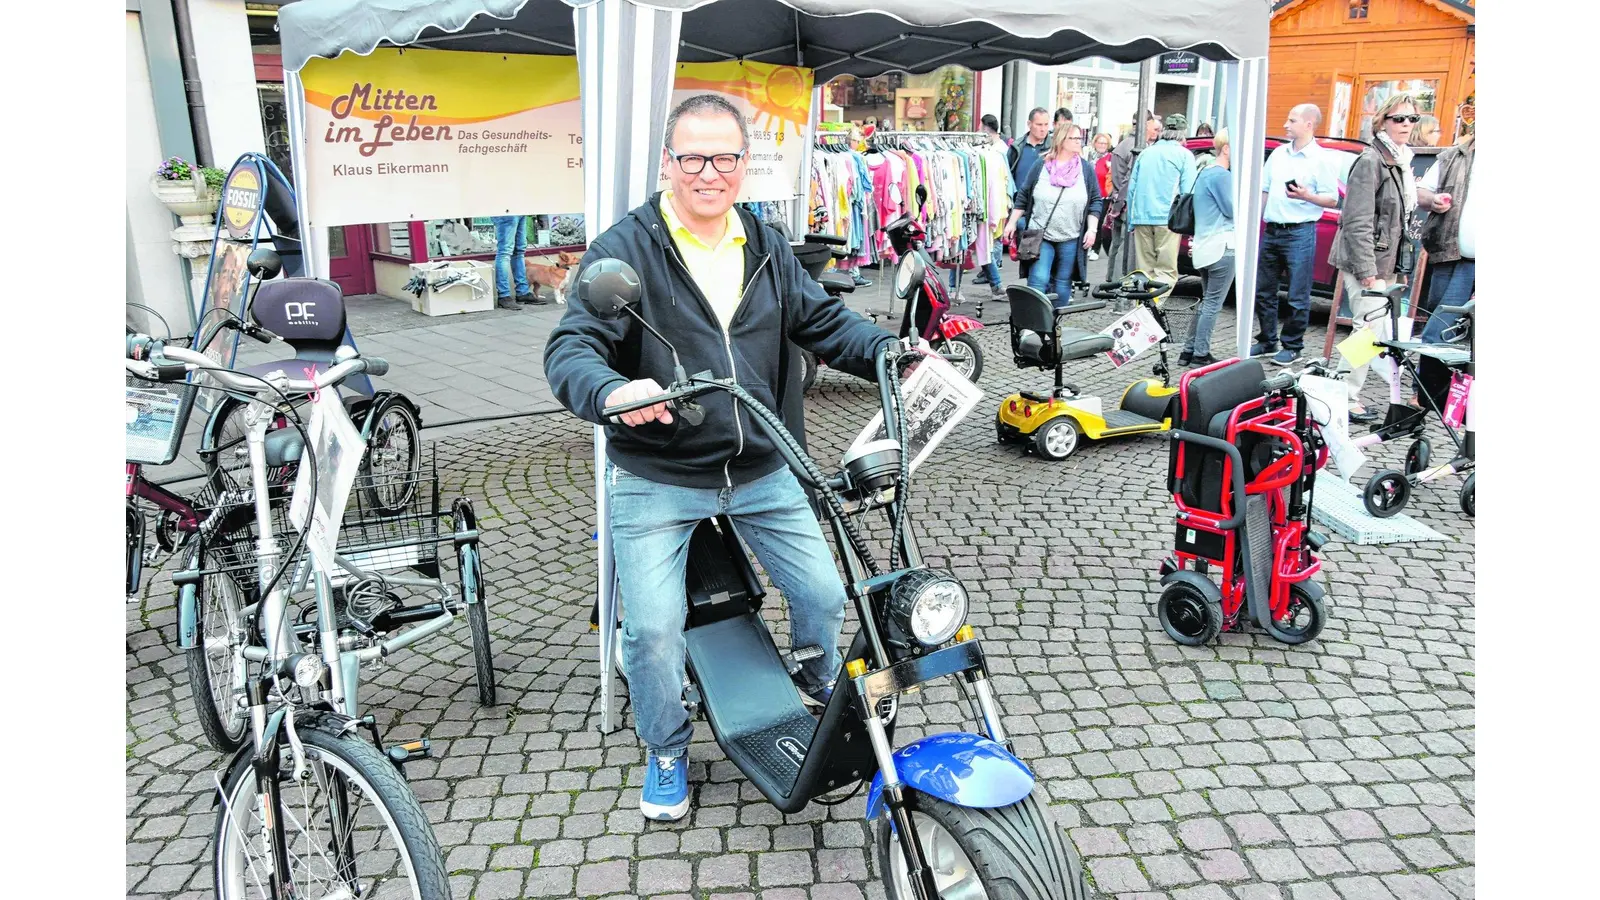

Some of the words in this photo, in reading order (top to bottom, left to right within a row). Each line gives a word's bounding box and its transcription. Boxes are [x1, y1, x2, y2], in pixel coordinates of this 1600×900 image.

[331, 82, 438, 119] Mitten
[324, 122, 364, 143] im
[358, 114, 453, 157] Leben
[457, 130, 479, 140] Das
[481, 130, 553, 141] Gesundheits-
[774, 132, 785, 142] 13
[458, 143, 528, 155] fachgeschäft
[333, 164, 373, 176] Klaus
[377, 162, 449, 175] Eikermann
[226, 188, 257, 210] FOSSIL
[284, 302, 316, 321] PF
